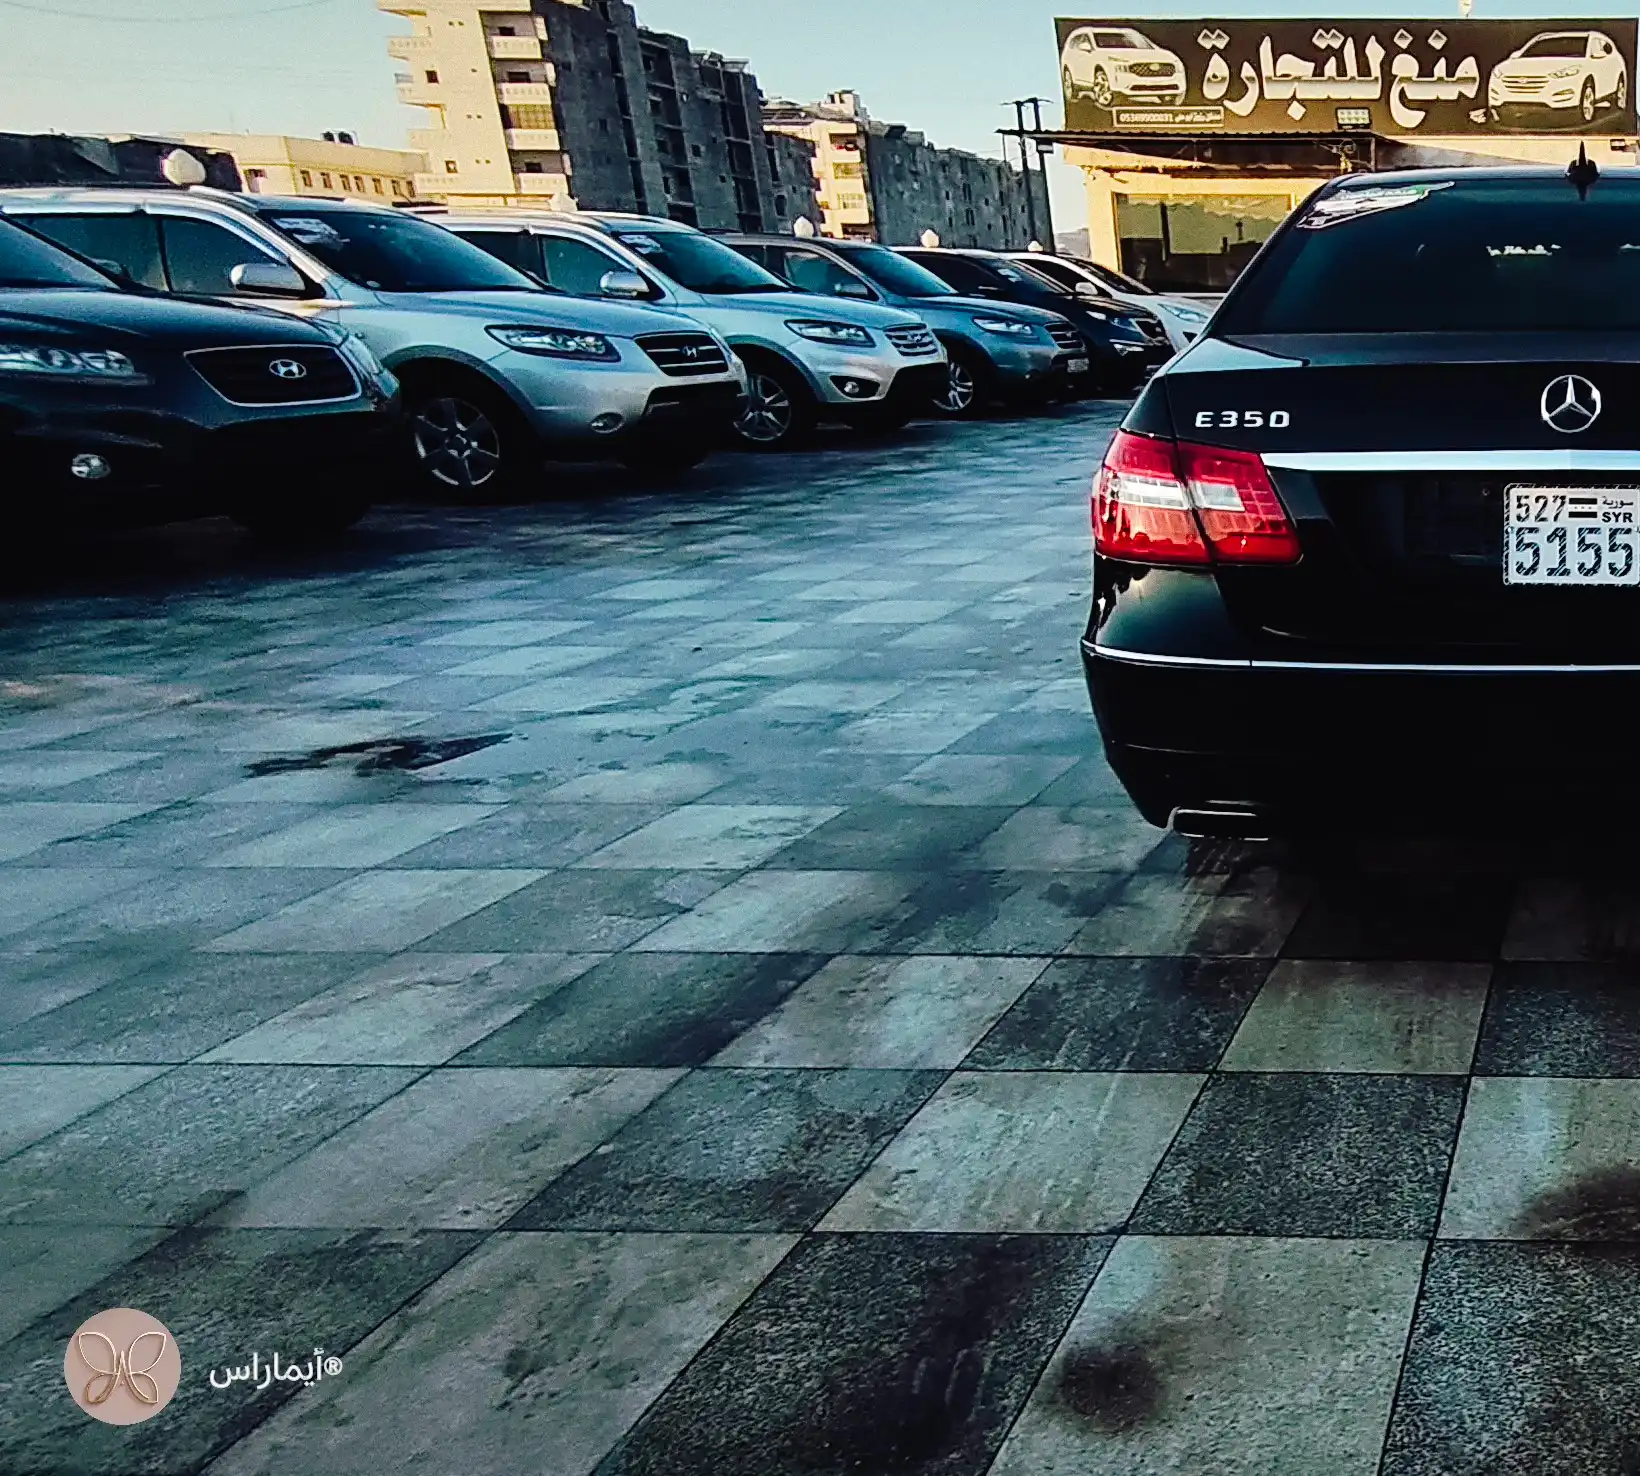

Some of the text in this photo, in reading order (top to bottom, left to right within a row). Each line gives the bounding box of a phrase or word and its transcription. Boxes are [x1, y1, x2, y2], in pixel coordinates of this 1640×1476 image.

[1197, 28, 1386, 121] للتجارة
[1195, 410, 1290, 428] E350
[1515, 495, 1566, 522] 527
[1601, 511, 1633, 523] SYR
[1515, 526, 1634, 577] 5155
